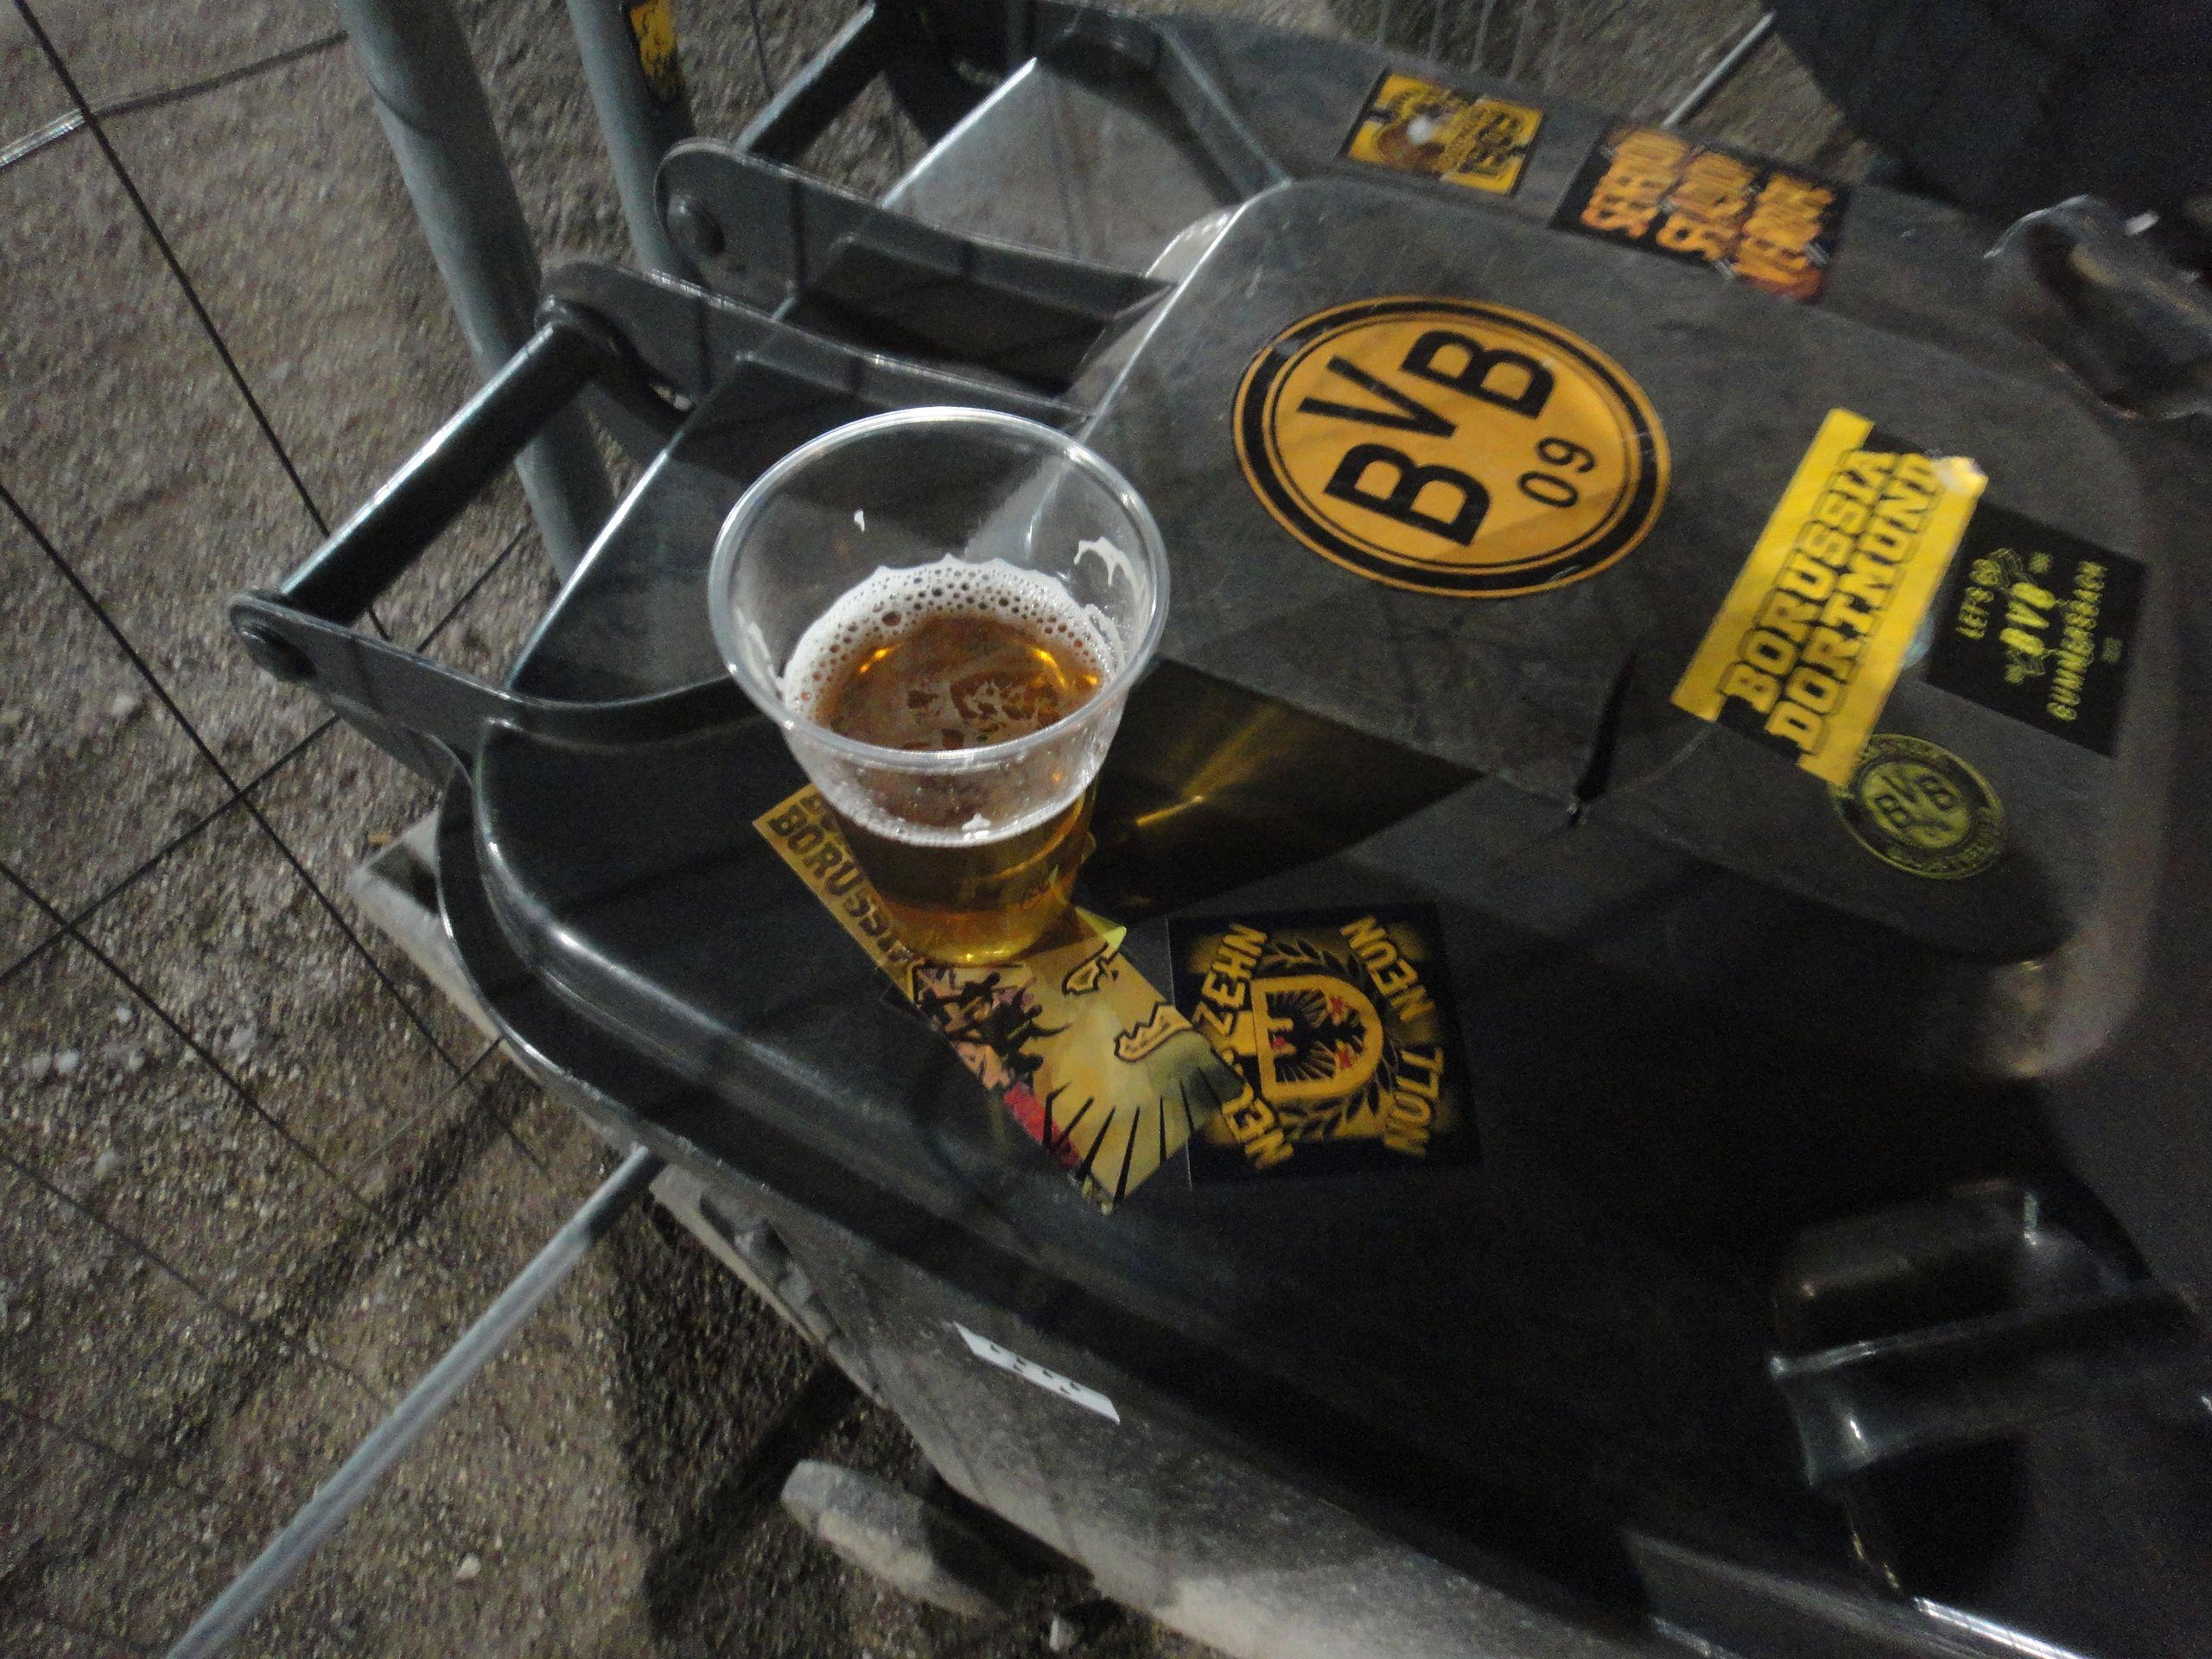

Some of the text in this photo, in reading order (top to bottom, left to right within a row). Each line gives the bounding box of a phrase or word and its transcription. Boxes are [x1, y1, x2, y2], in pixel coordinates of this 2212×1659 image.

[1298, 330, 1556, 547] BVB
[1516, 436, 1596, 509] 09
[1726, 448, 1901, 715] BORUSSIA
[1764, 453, 1944, 756] DORTMUND
[1194, 922, 1270, 1042] ZEHN
[1340, 914, 1445, 1160] NULL NEUN
